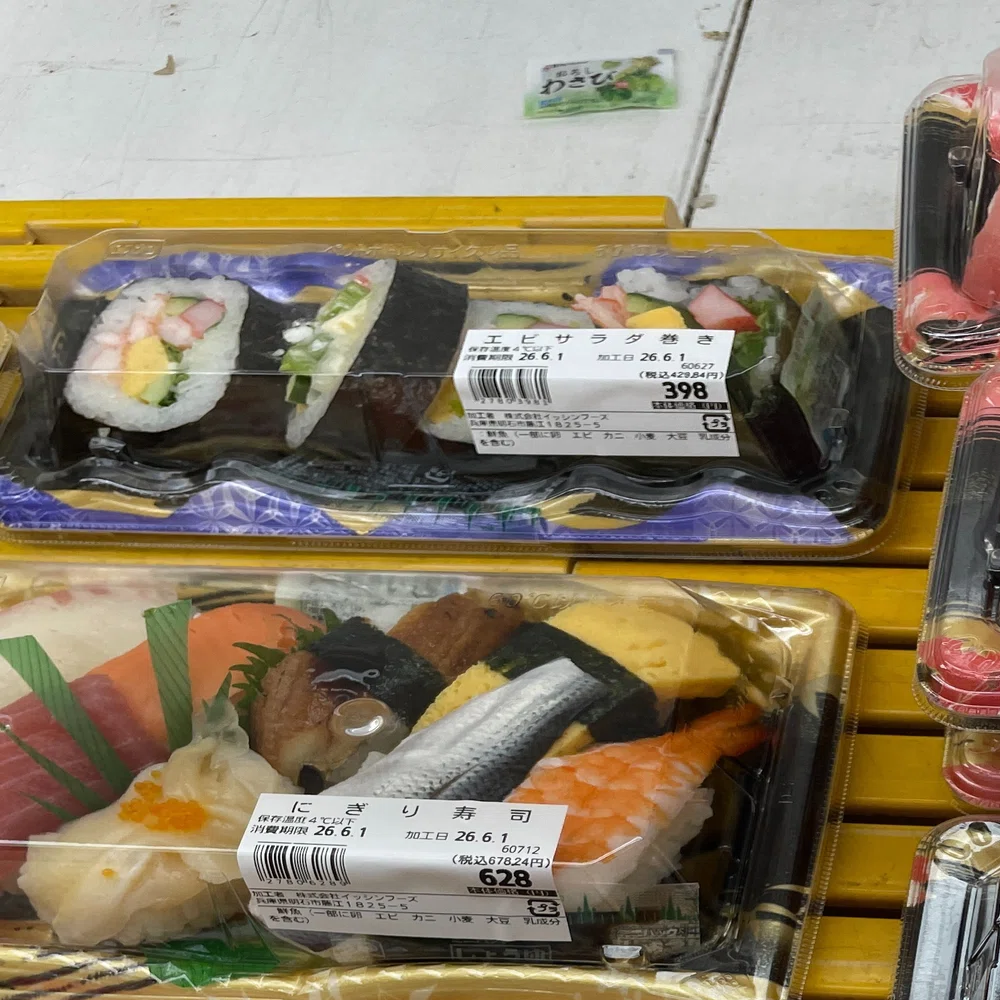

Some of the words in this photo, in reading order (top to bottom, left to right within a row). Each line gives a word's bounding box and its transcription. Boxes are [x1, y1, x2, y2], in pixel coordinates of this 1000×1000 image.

[540, 70, 618, 95] わさび
[483, 334, 715, 344] エビサラダ巻き
[518, 352, 564, 361] 26.6.1
[639, 353, 685, 362] 26.6.1
[662, 382, 709, 399] 398
[603, 432, 625, 440] カニ
[291, 802, 533, 823] にぎり寿司
[250, 826, 309, 835] 消費期限
[313, 826, 367, 838] 26.6.1
[405, 831, 449, 840] 加工日
[454, 831, 508, 843] 26.6.1
[501, 845, 540, 854] 60712
[478, 869, 533, 887] 628
[375, 912, 399, 921] エビ
[412, 914, 436, 922] カニ
[449, 915, 474, 923] 小麦
[486, 916, 511, 925] 大豆
[523, 917, 560, 926] 乳成分
